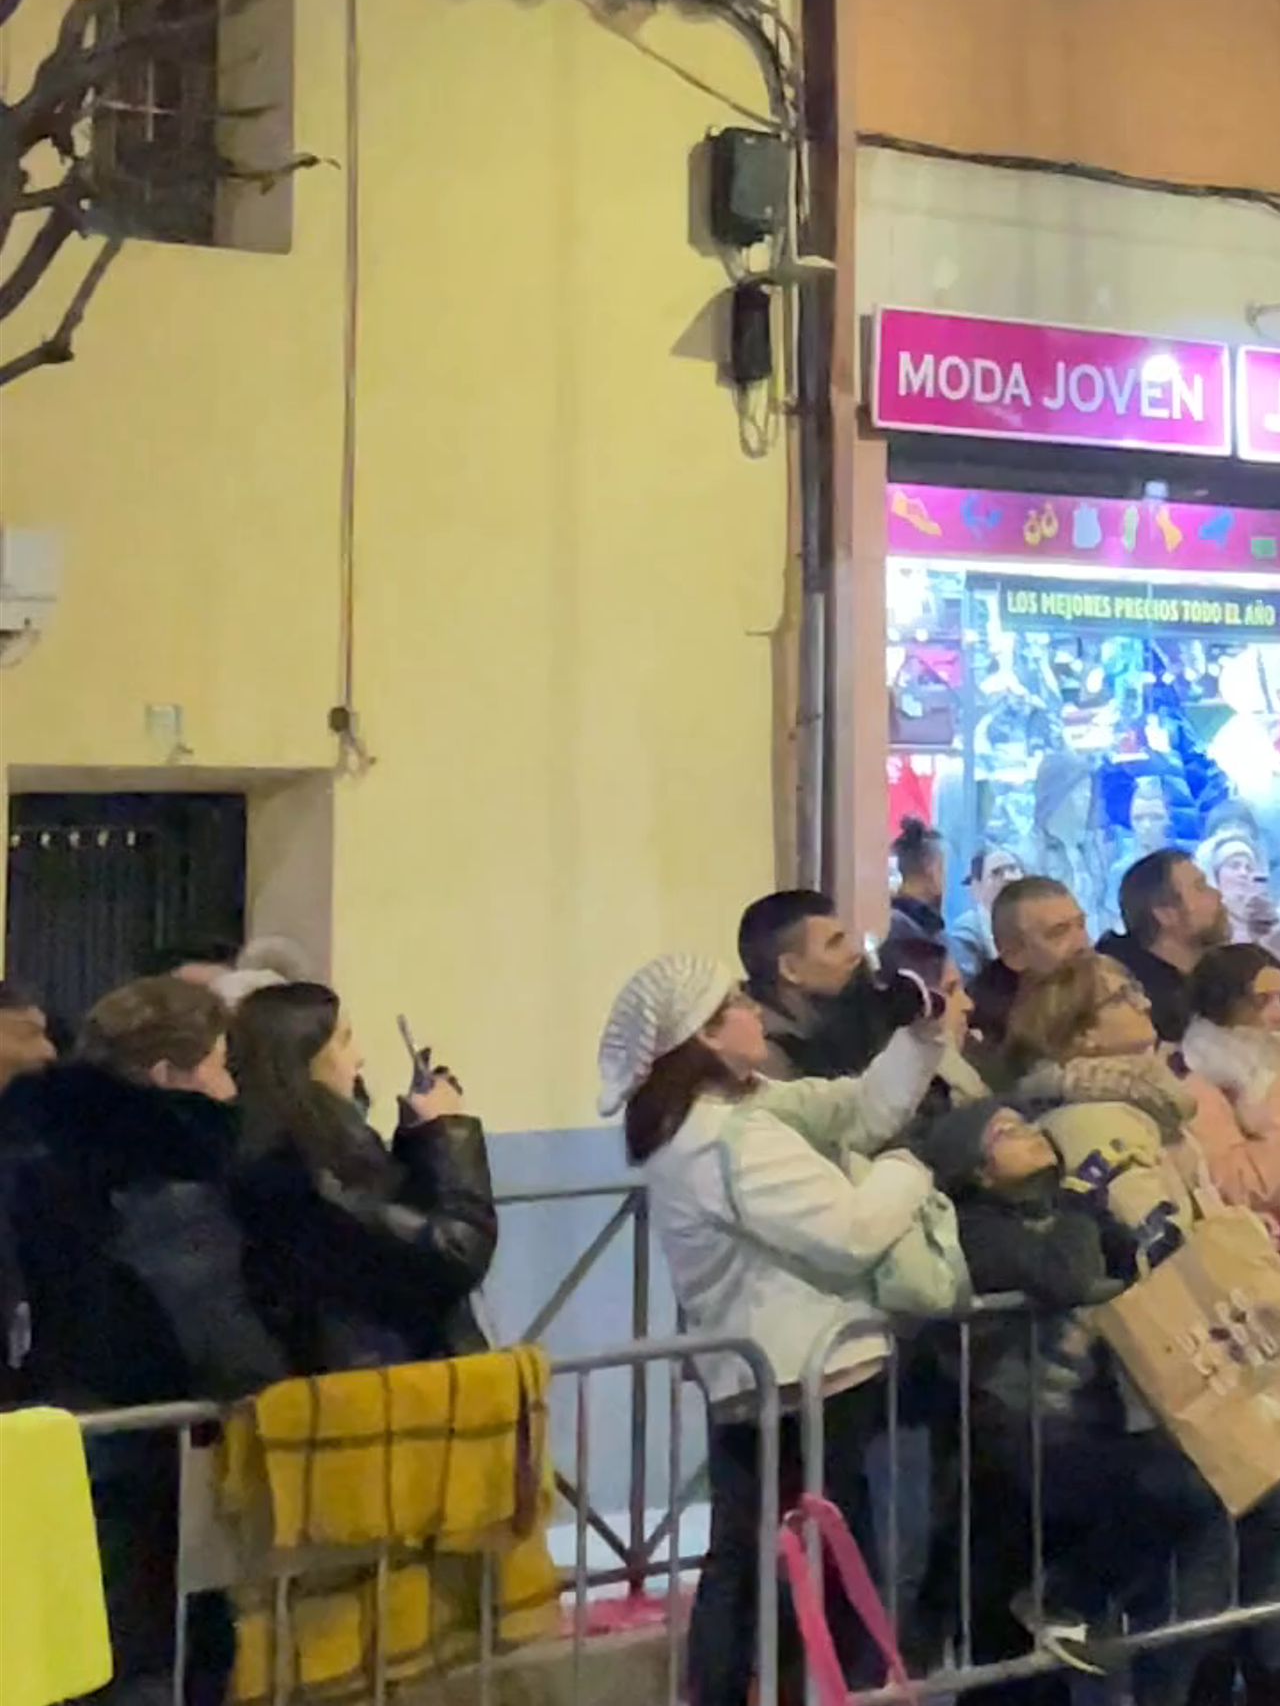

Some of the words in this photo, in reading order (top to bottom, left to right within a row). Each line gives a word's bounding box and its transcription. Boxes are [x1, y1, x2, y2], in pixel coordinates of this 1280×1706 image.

[898, 351, 1032, 408] MODA
[1042, 360, 1204, 422] JOVEN
[1007, 589, 1038, 614] LOS
[1041, 592, 1112, 620] MEJORES
[1114, 596, 1180, 622] PRECIOS
[1182, 601, 1222, 624] TODO
[1224, 603, 1242, 625] EL
[1244, 600, 1276, 627] AÑO
